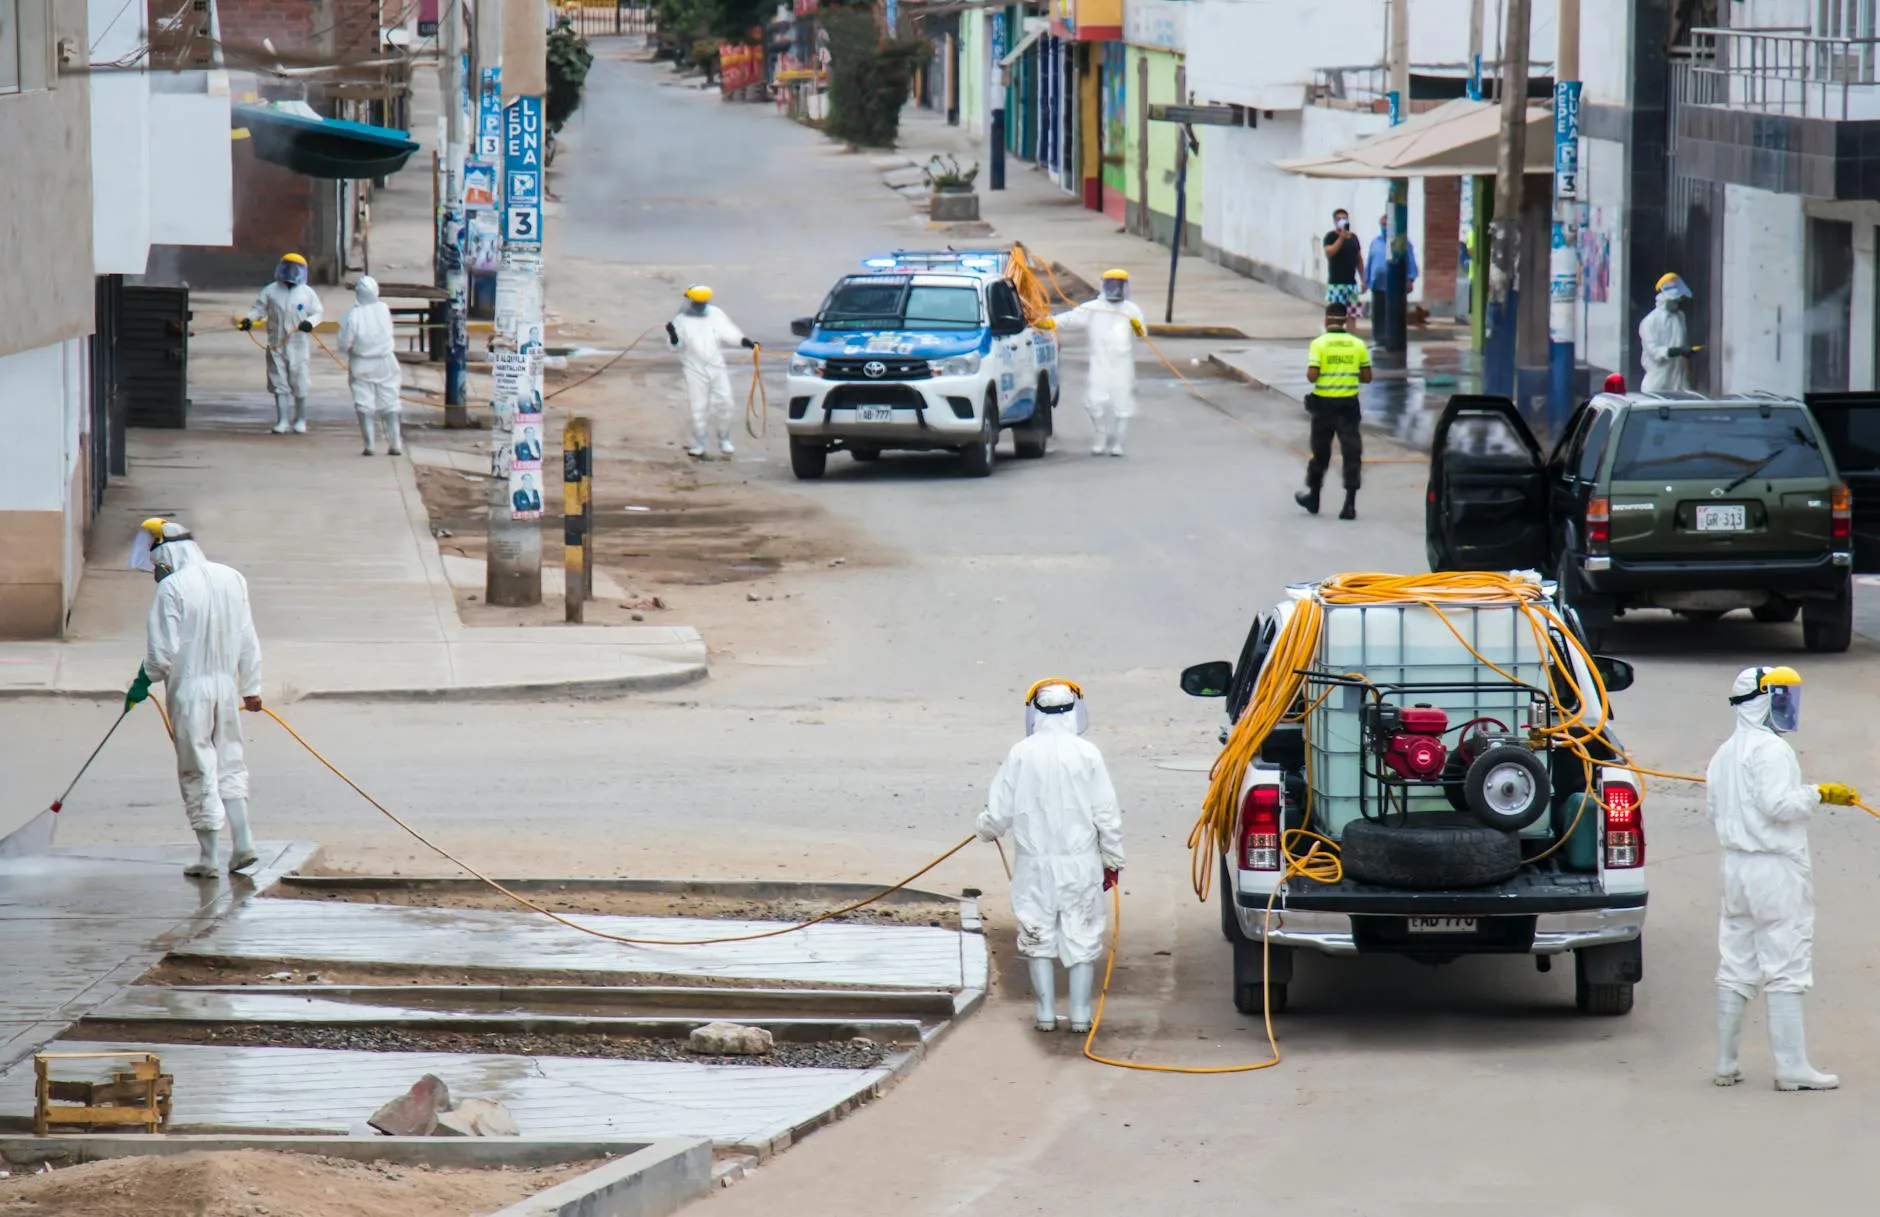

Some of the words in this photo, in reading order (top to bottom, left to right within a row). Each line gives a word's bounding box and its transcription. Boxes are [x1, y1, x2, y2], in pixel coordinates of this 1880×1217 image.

[508, 107, 521, 156] EPE
[523, 99, 537, 166] LUNA
[1558, 83, 1568, 133] PEPE
[1568, 89, 1578, 140] LUNA
[487, 140, 496, 152] 3
[1563, 175, 1575, 192] 3
[515, 212, 533, 235] 3
